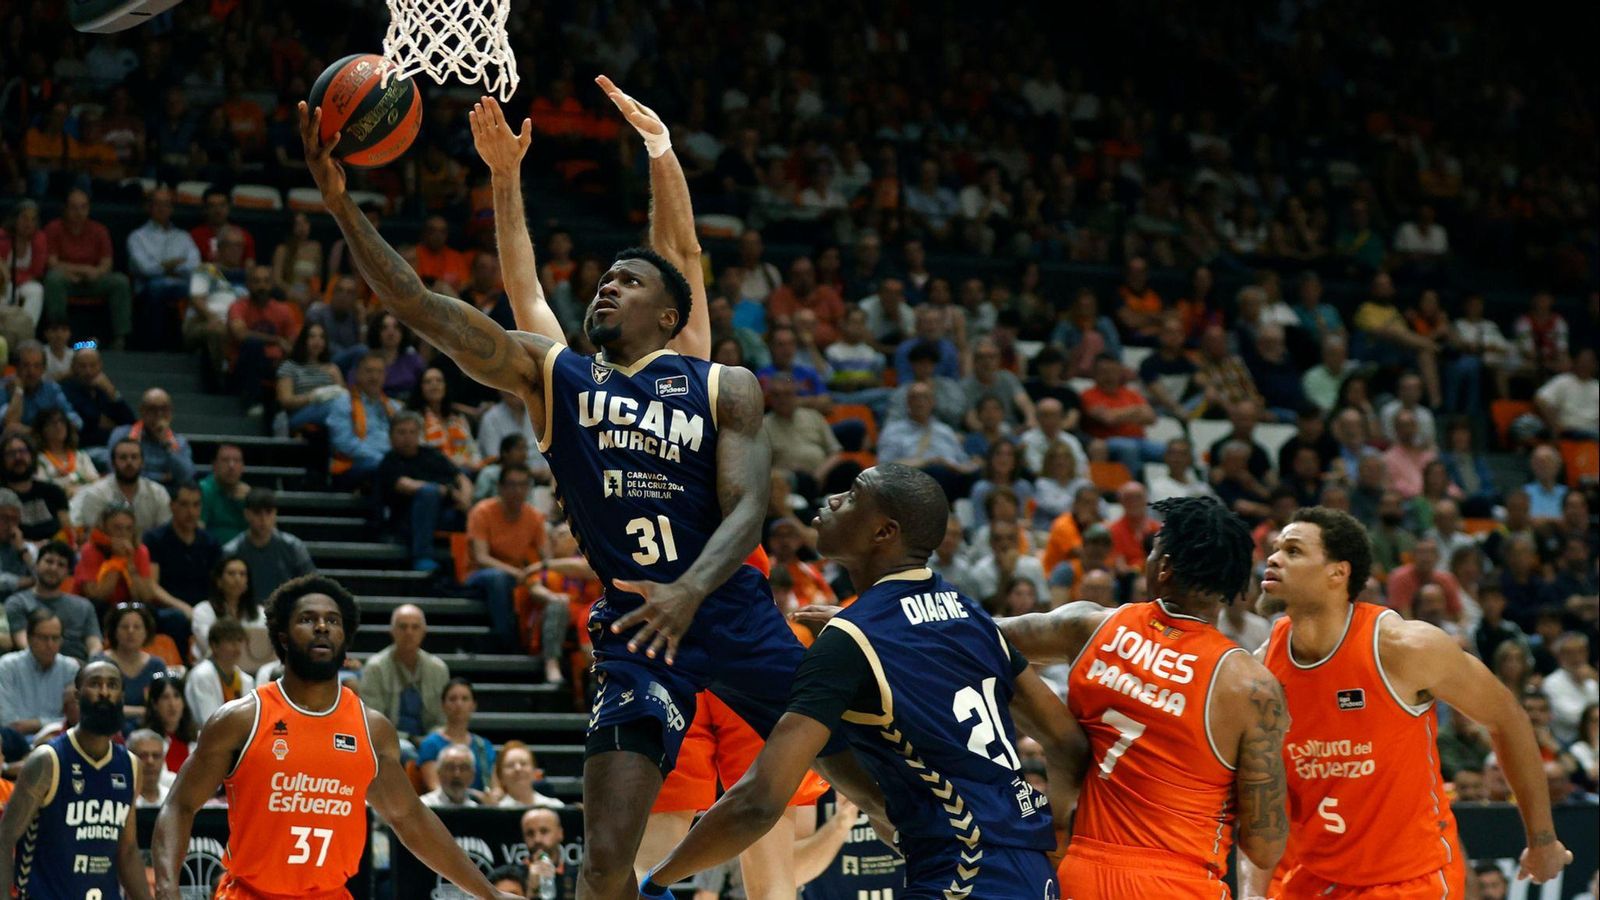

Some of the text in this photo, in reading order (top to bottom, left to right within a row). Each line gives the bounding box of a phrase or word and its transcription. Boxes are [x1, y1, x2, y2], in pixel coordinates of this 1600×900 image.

[578, 391, 704, 452] UCAM
[598, 430, 681, 463] MURCIA
[626, 471, 668, 481] CARAVACA
[647, 482, 667, 490] CRUZ
[627, 488, 672, 499] AÑO JUBILAR
[626, 515, 678, 566] 31
[900, 591, 969, 626] DIAGNE
[1101, 626, 1198, 684] JONES
[1098, 708, 1147, 780] 7
[1287, 740, 1373, 760] Cultura del
[271, 772, 354, 796] Cultura del
[1295, 759, 1375, 779] Esfuerzo
[65, 799, 130, 827] UCAM
[268, 792, 352, 816] Esfuerzo
[1318, 796, 1346, 834] 5
[287, 826, 334, 867] 37
